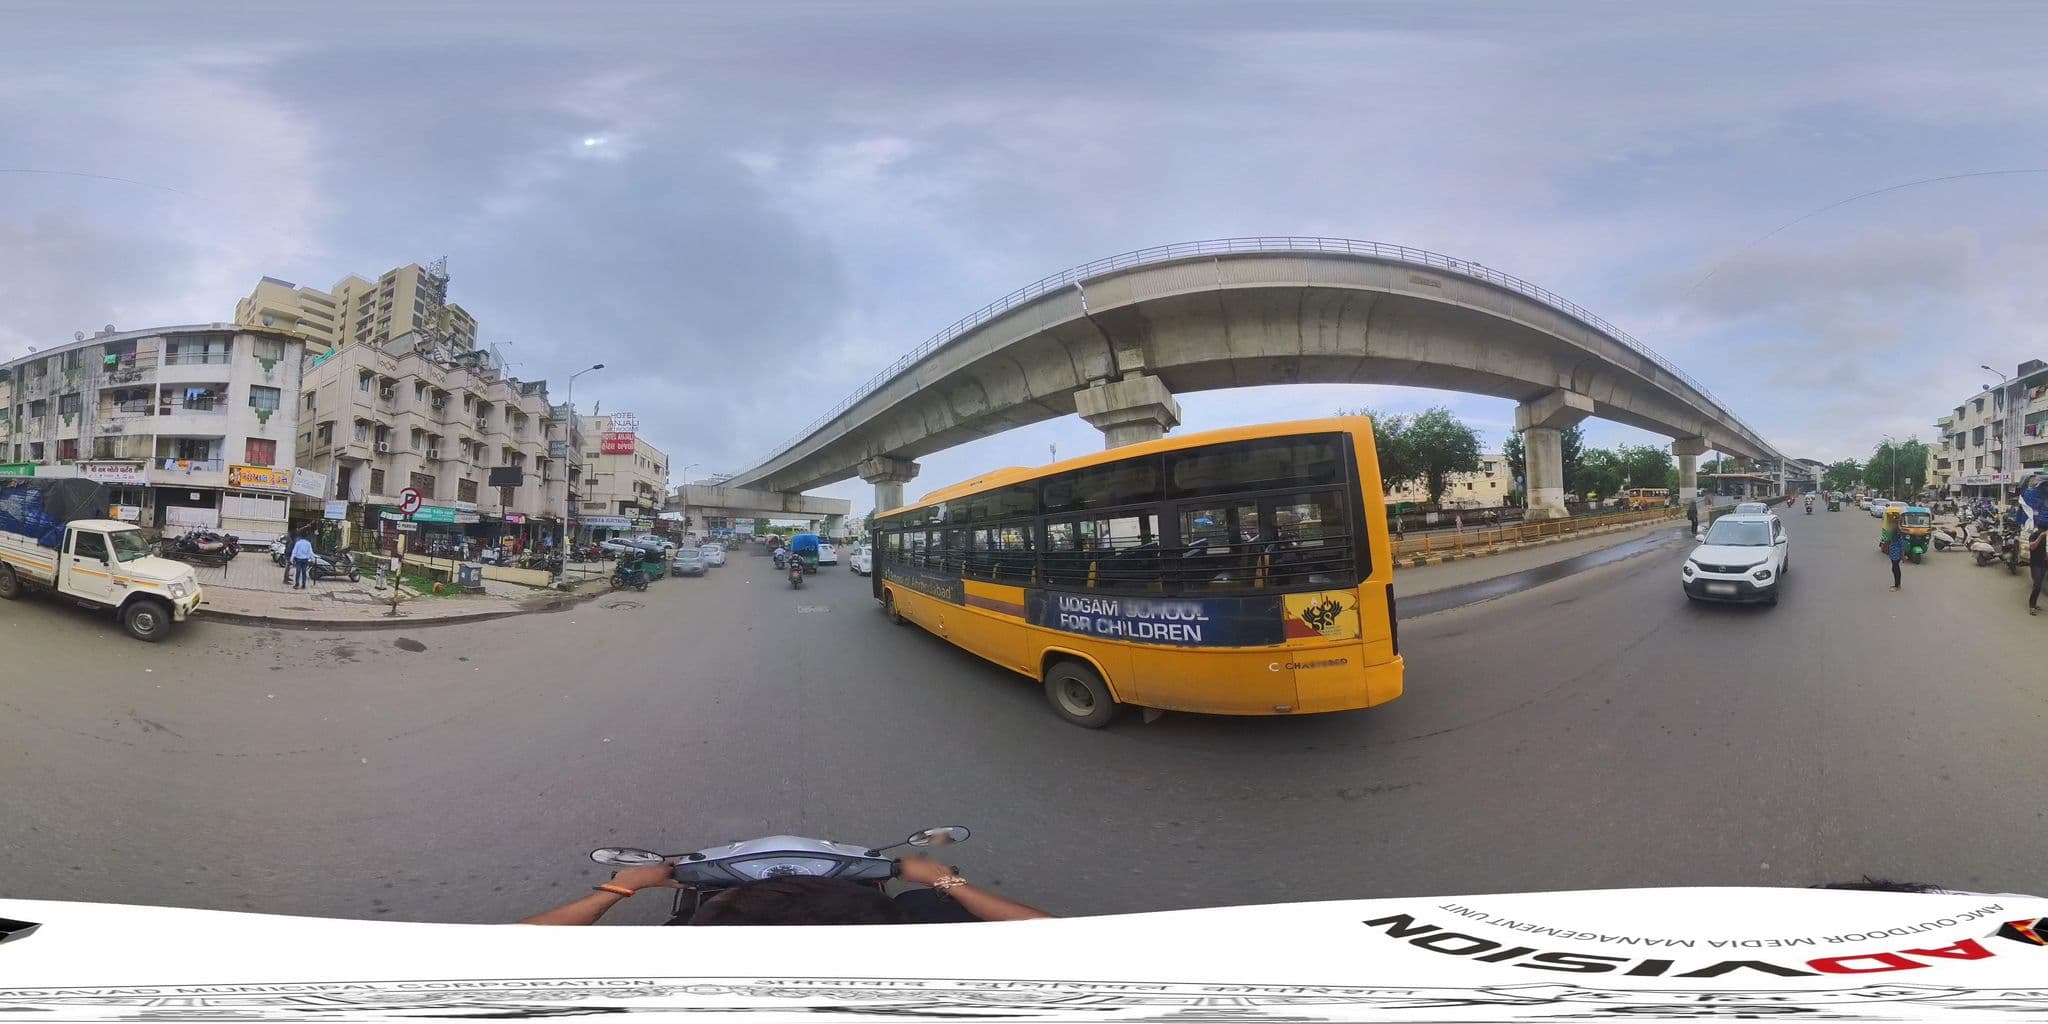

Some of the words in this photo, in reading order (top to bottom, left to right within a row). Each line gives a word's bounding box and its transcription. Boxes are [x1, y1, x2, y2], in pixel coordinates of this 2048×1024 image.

[607, 419, 640, 427] ANJALI
[1059, 596, 1119, 617] UDGAM
[1060, 613, 1091, 631] FOR
[1096, 618, 1203, 642] CHILDREN
[1285, 657, 1348, 670] CHAERED
